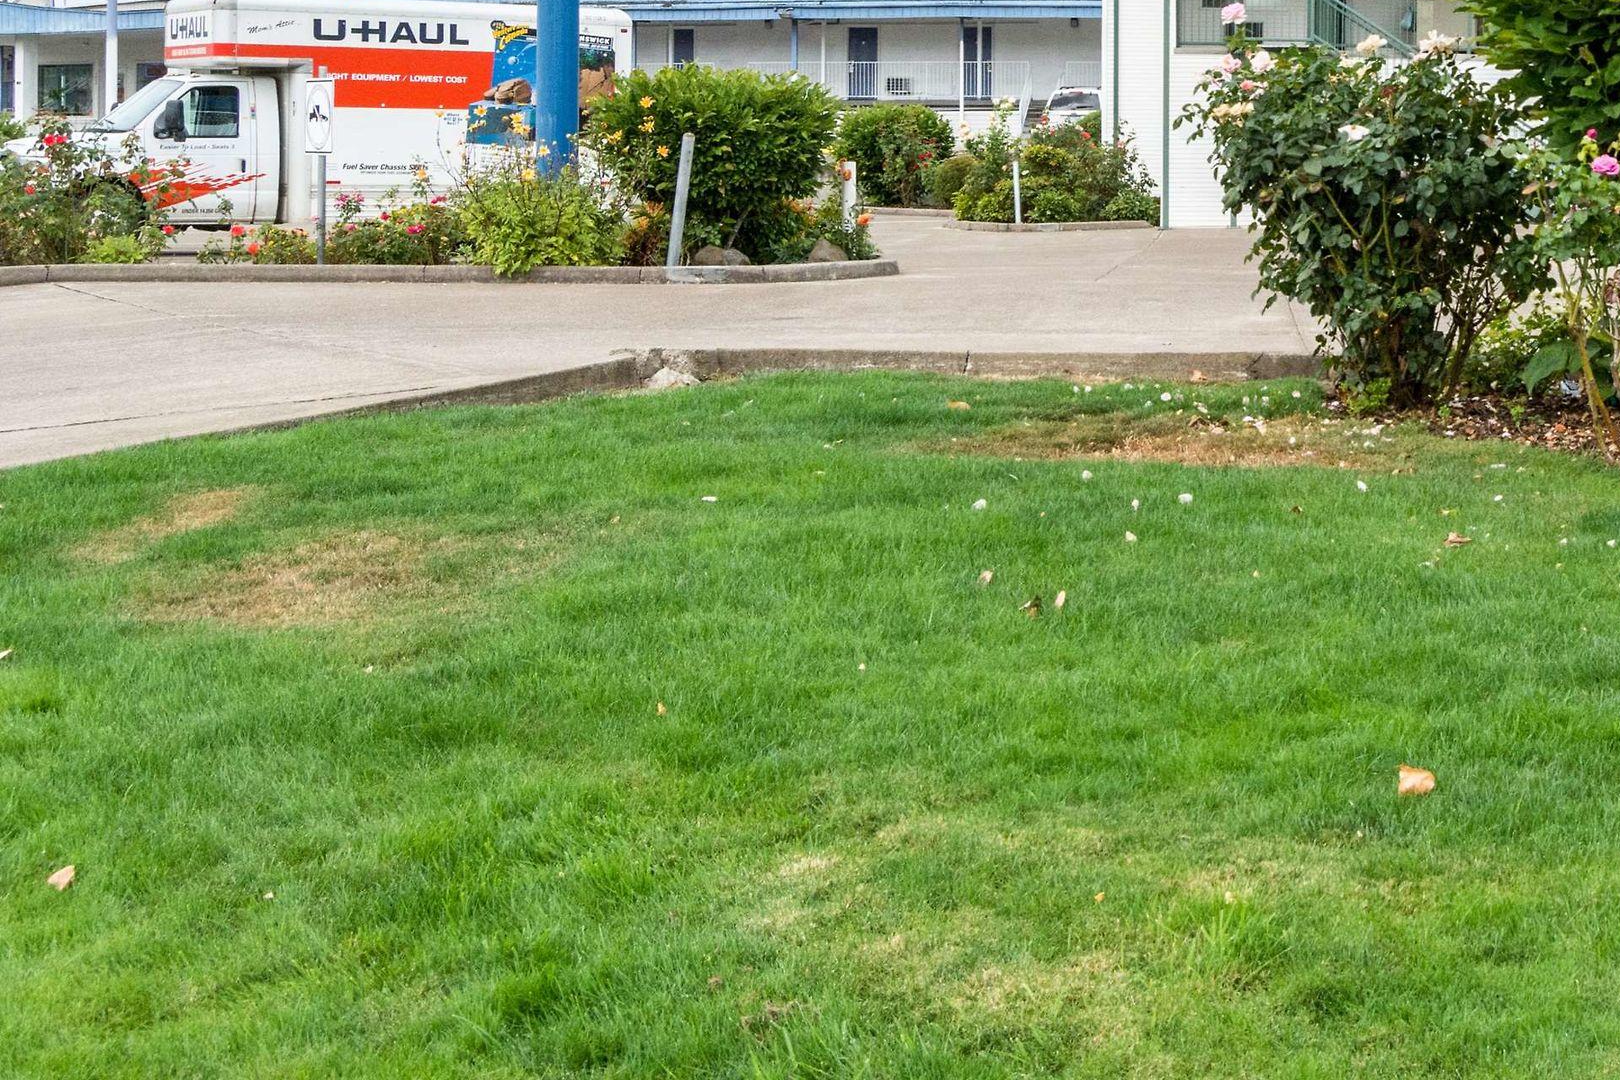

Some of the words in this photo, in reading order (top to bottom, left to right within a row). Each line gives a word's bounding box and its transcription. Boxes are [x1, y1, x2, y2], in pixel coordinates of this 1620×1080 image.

[170, 15, 209, 40] U-HAUL
[313, 18, 470, 46] U-HAUL
[326, 72, 349, 81] IGHT
[351, 72, 402, 82] EQUIPMENT
[409, 74, 443, 84] LOWEST
[445, 75, 468, 84] COST
[359, 163, 379, 171] Saver
[380, 163, 407, 171] Chassis
